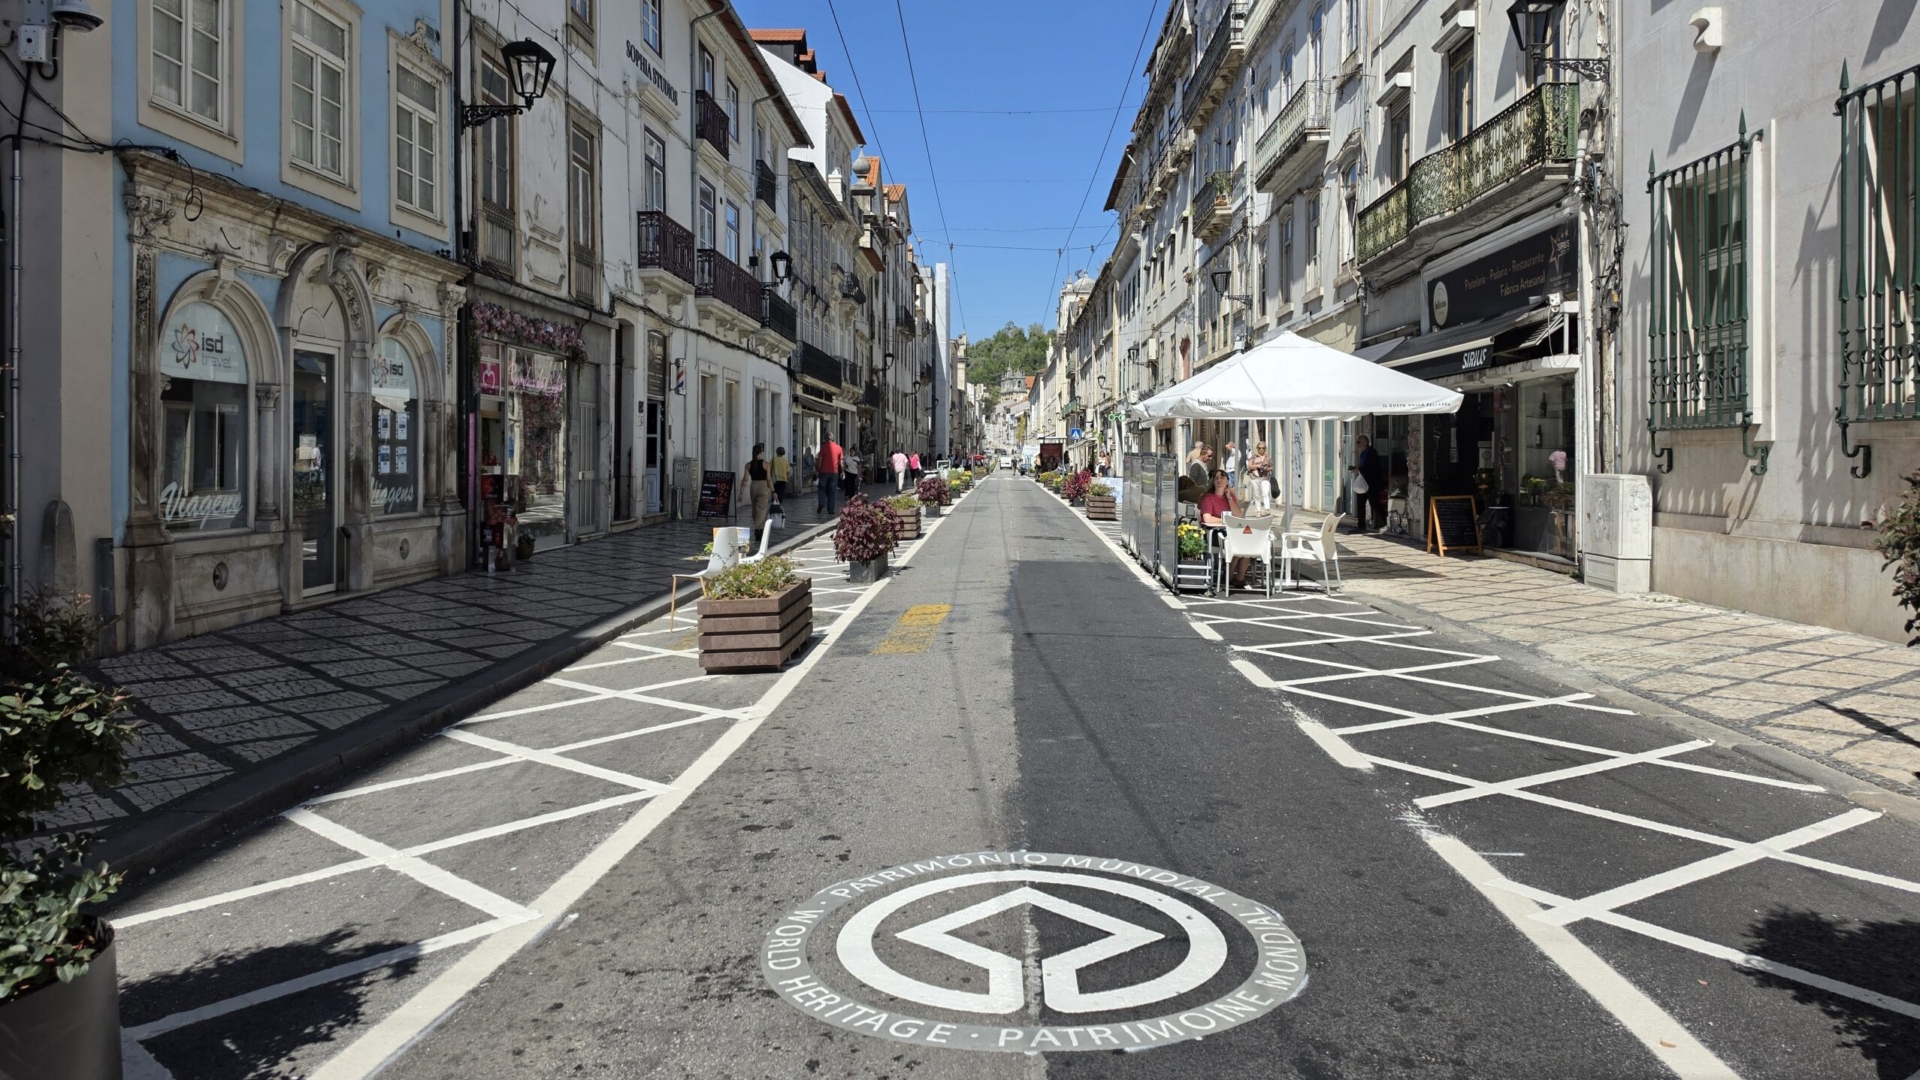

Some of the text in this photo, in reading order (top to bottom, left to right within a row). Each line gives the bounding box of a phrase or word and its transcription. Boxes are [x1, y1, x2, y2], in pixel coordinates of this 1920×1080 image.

[626, 40, 678, 106] SOPHIA STUDIOS
[1464, 254, 1544, 290] Pastelaria Padaria Restaurante
[1500, 282, 1519, 297] Fabrico
[1520, 270, 1546, 291] Artesanal
[202, 332, 224, 353] isd
[202, 354, 232, 368] travel
[389, 360, 403, 376] isd
[1462, 348, 1488, 370] SIRIUS
[1197, 398, 1231, 406] bellissimo
[159, 481, 243, 530] Viagens
[829, 853, 1226, 902] PATRIMÓNIO MUNDIAL
[768, 910, 957, 1043] WORLD HERITAGE
[998, 906, 1300, 1047] PATRIMOINE MONDIAL
